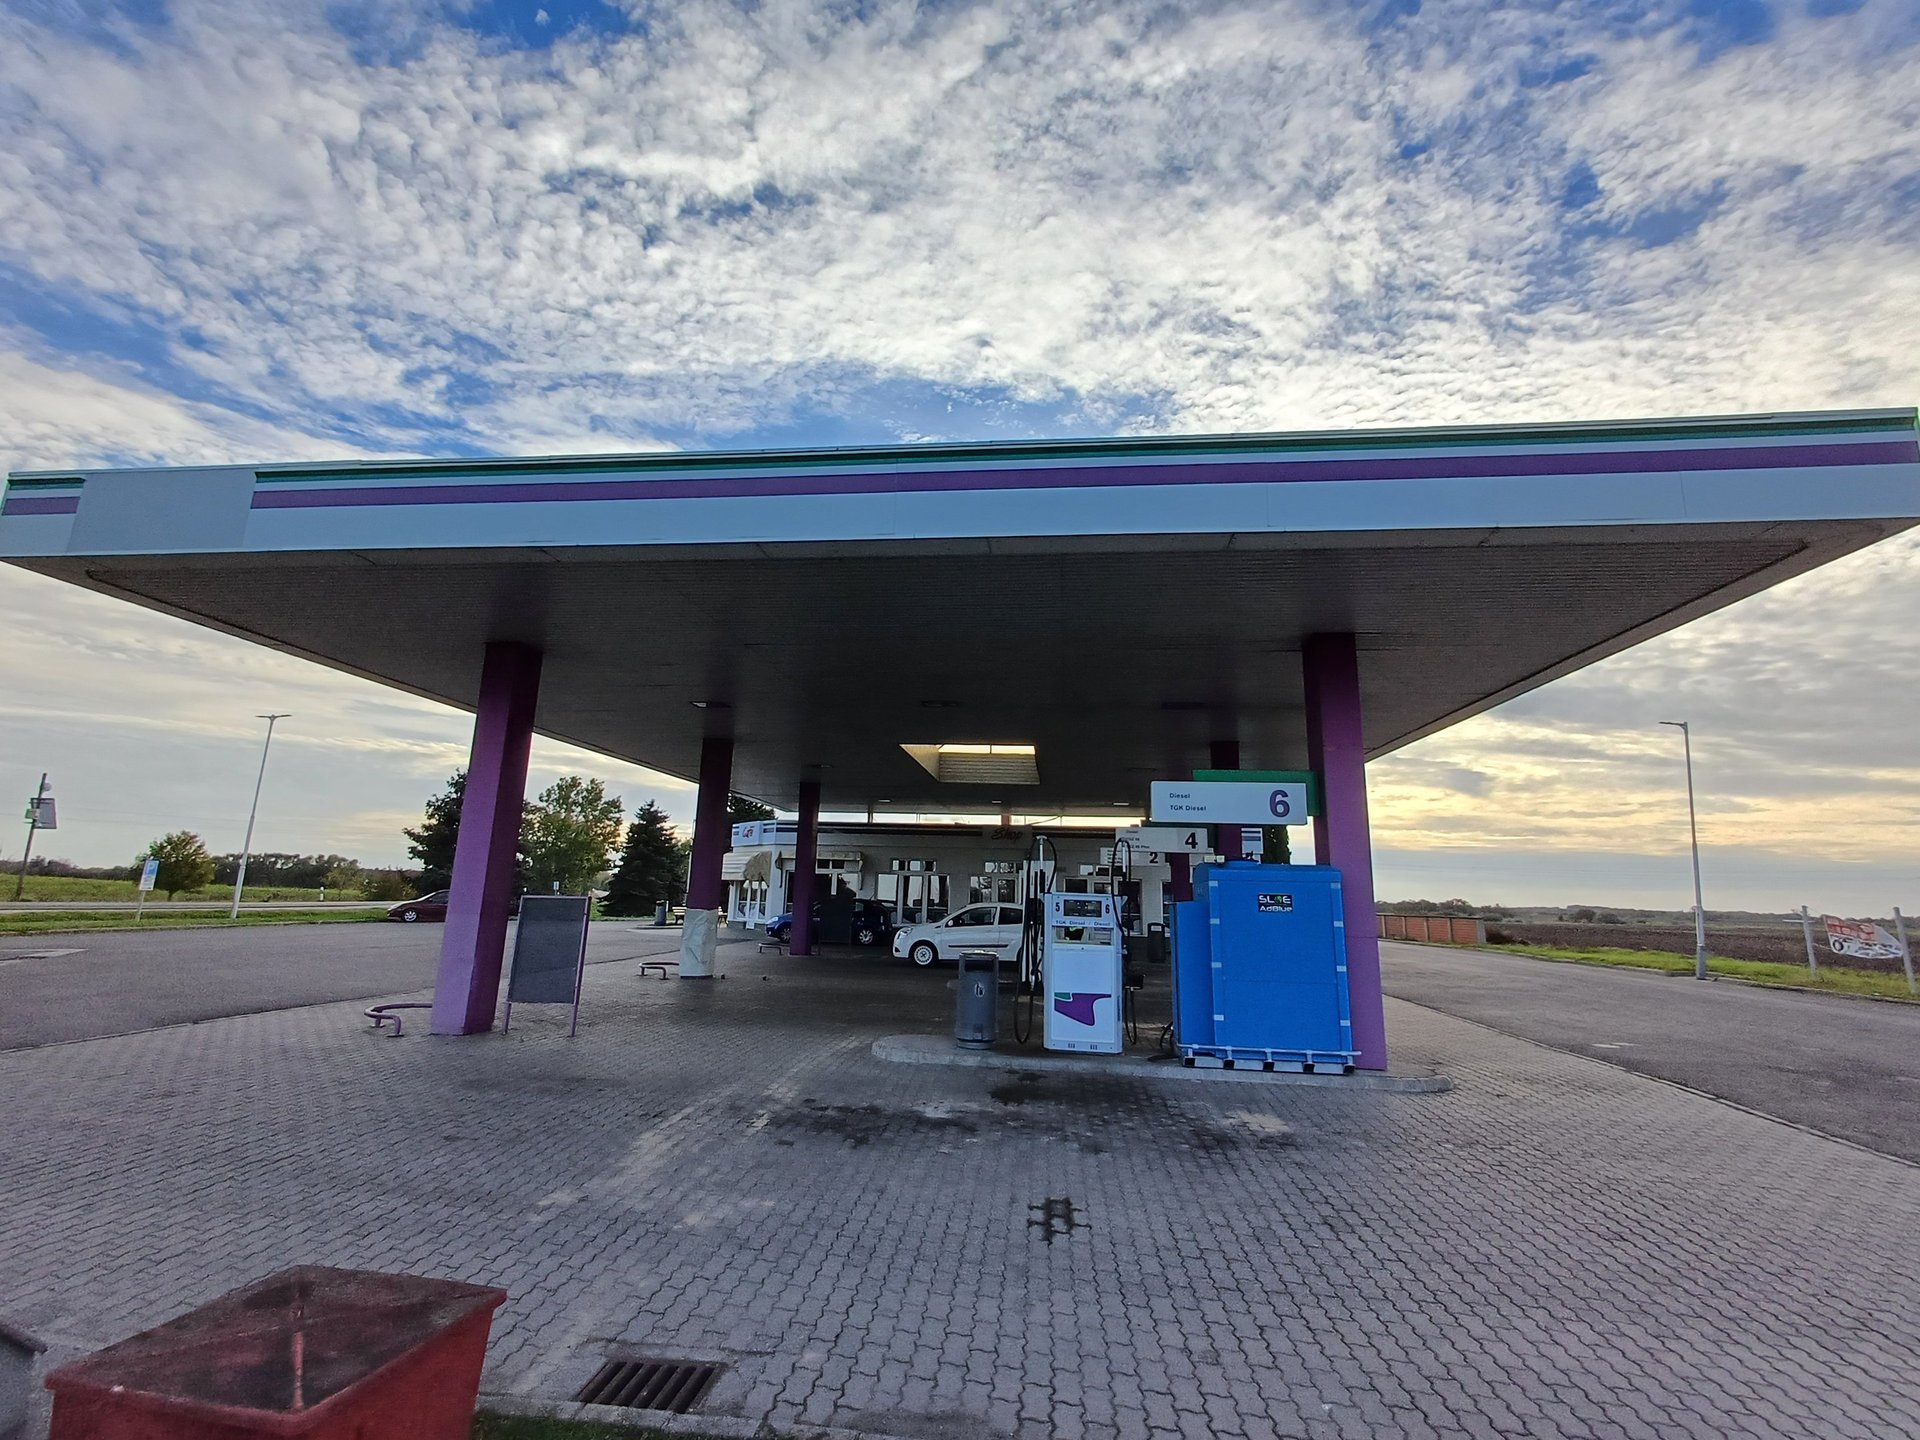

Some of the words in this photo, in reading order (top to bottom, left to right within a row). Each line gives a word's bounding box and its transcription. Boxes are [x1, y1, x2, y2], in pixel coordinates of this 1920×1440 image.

[1269, 789, 1290, 818] 6
[991, 826, 1023, 843] Shop
[1185, 832, 1198, 849] 4
[1149, 851, 1159, 864] 2
[146, 862, 155, 874] P
[1055, 902, 1060, 912] 5
[1105, 903, 1110, 914] 6
